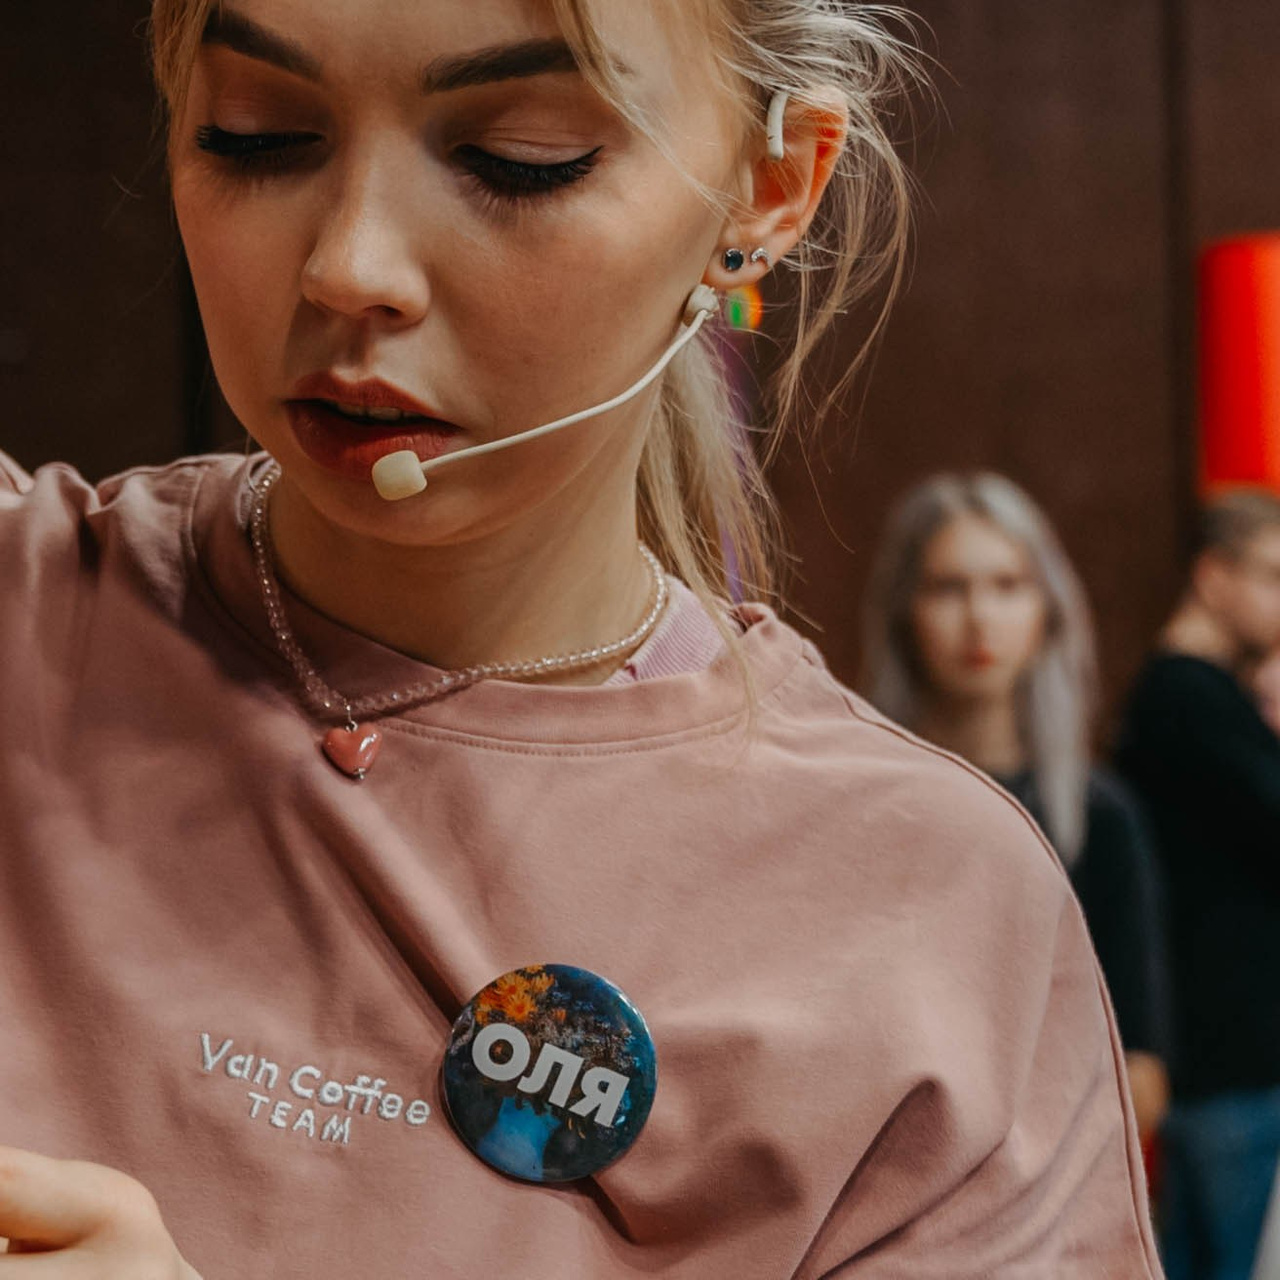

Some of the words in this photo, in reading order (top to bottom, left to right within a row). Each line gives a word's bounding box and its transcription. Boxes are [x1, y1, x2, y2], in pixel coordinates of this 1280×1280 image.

[199, 1032, 280, 1088] Van
[289, 1064, 431, 1126] Coffee
[247, 1091, 351, 1145] TEAM
[471, 1022, 630, 1128] ОЛЯ
